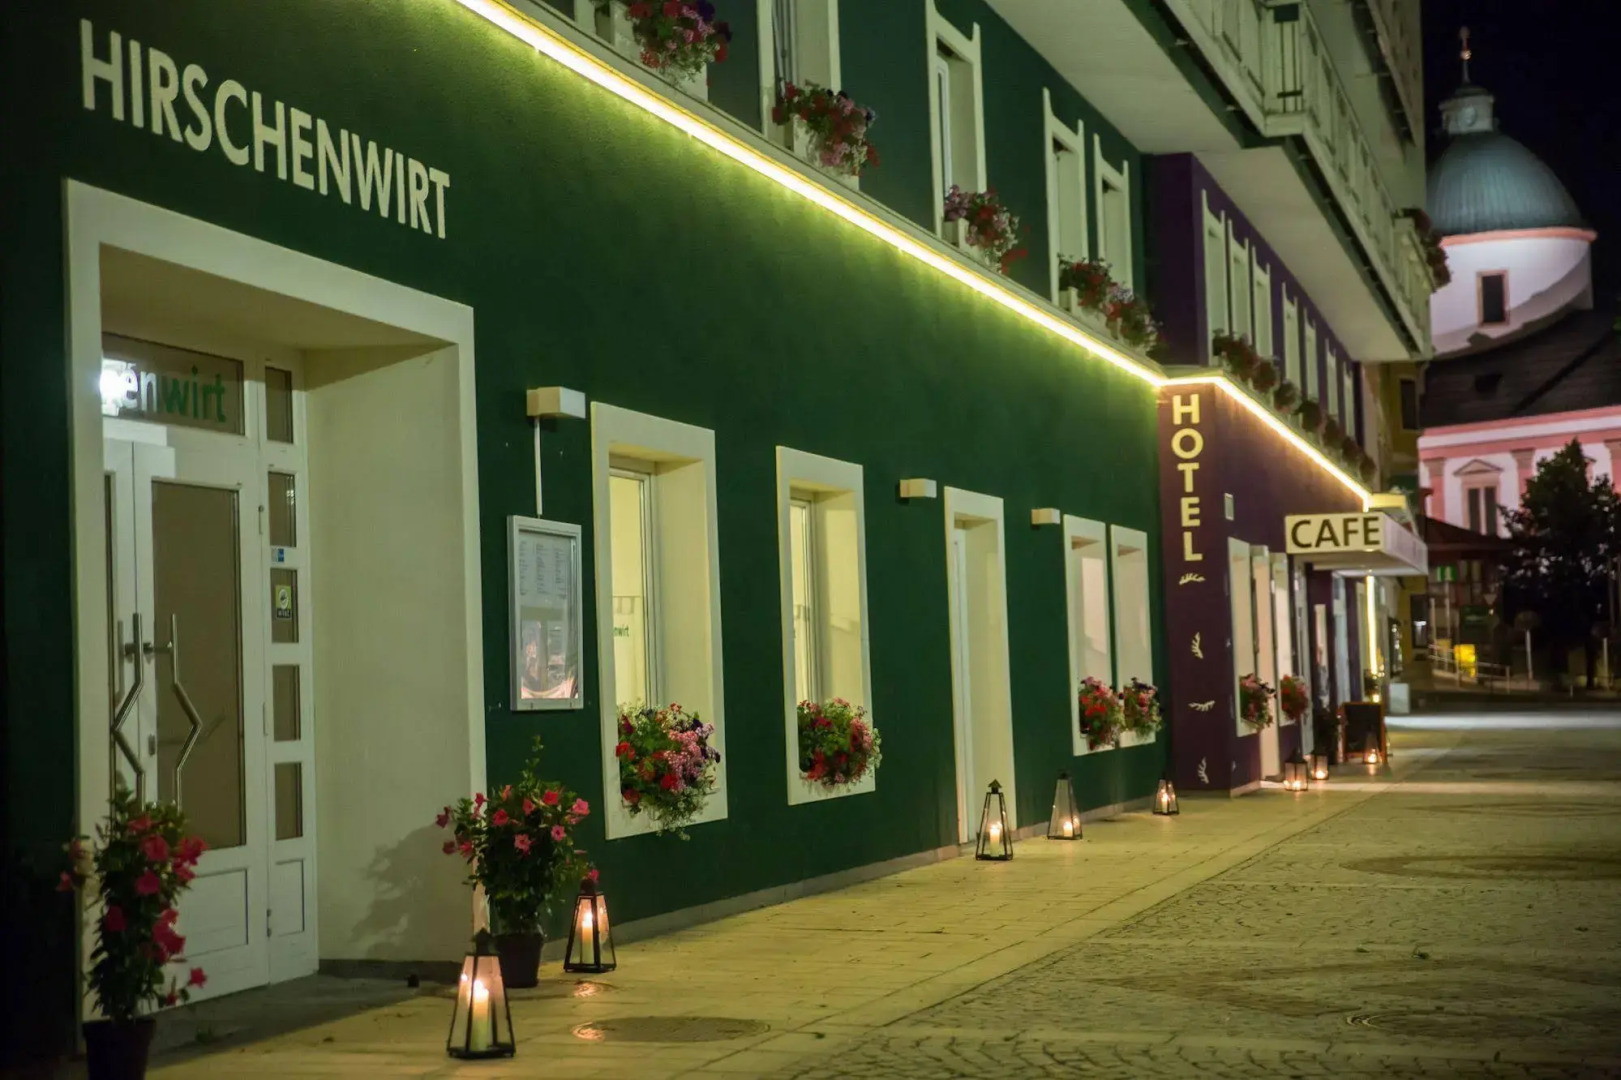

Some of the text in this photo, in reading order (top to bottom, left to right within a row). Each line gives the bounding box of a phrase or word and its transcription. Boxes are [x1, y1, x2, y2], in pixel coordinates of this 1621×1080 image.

[80, 18, 450, 239] HIRSCHENWIRT
[105, 363, 226, 423] enwirt
[1171, 393, 1204, 561] HOTEL
[1291, 516, 1381, 548] CAFE
